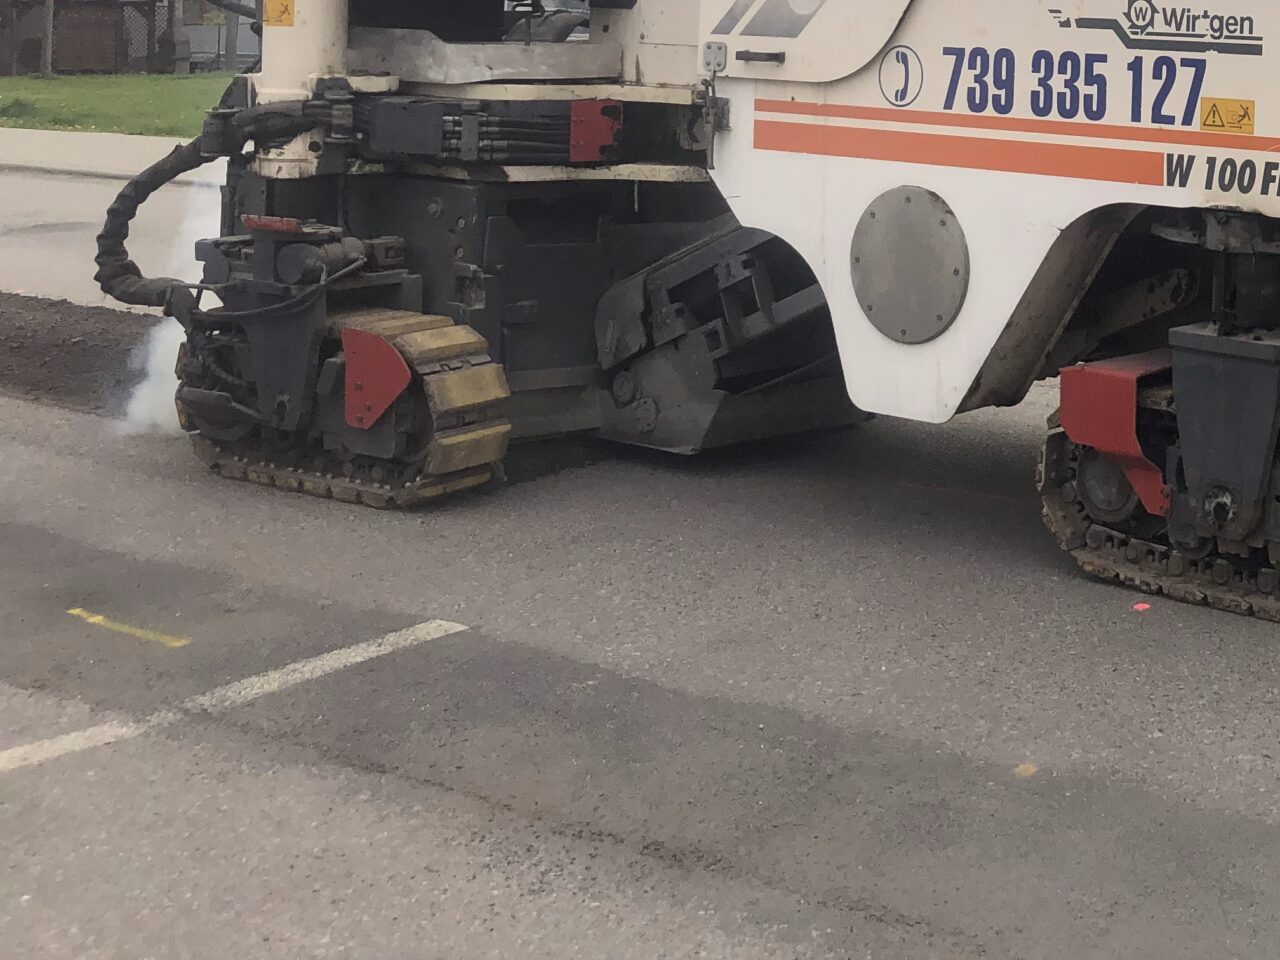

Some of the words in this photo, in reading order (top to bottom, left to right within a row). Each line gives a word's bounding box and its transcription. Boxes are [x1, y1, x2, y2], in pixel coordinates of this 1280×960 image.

[1133, 6, 1149, 22] W
[942, 46, 1016, 115] 739
[1030, 50, 1109, 121] 335
[1127, 55, 1207, 126] 127
[1166, 152, 1196, 188] W
[1204, 156, 1257, 195] 100
